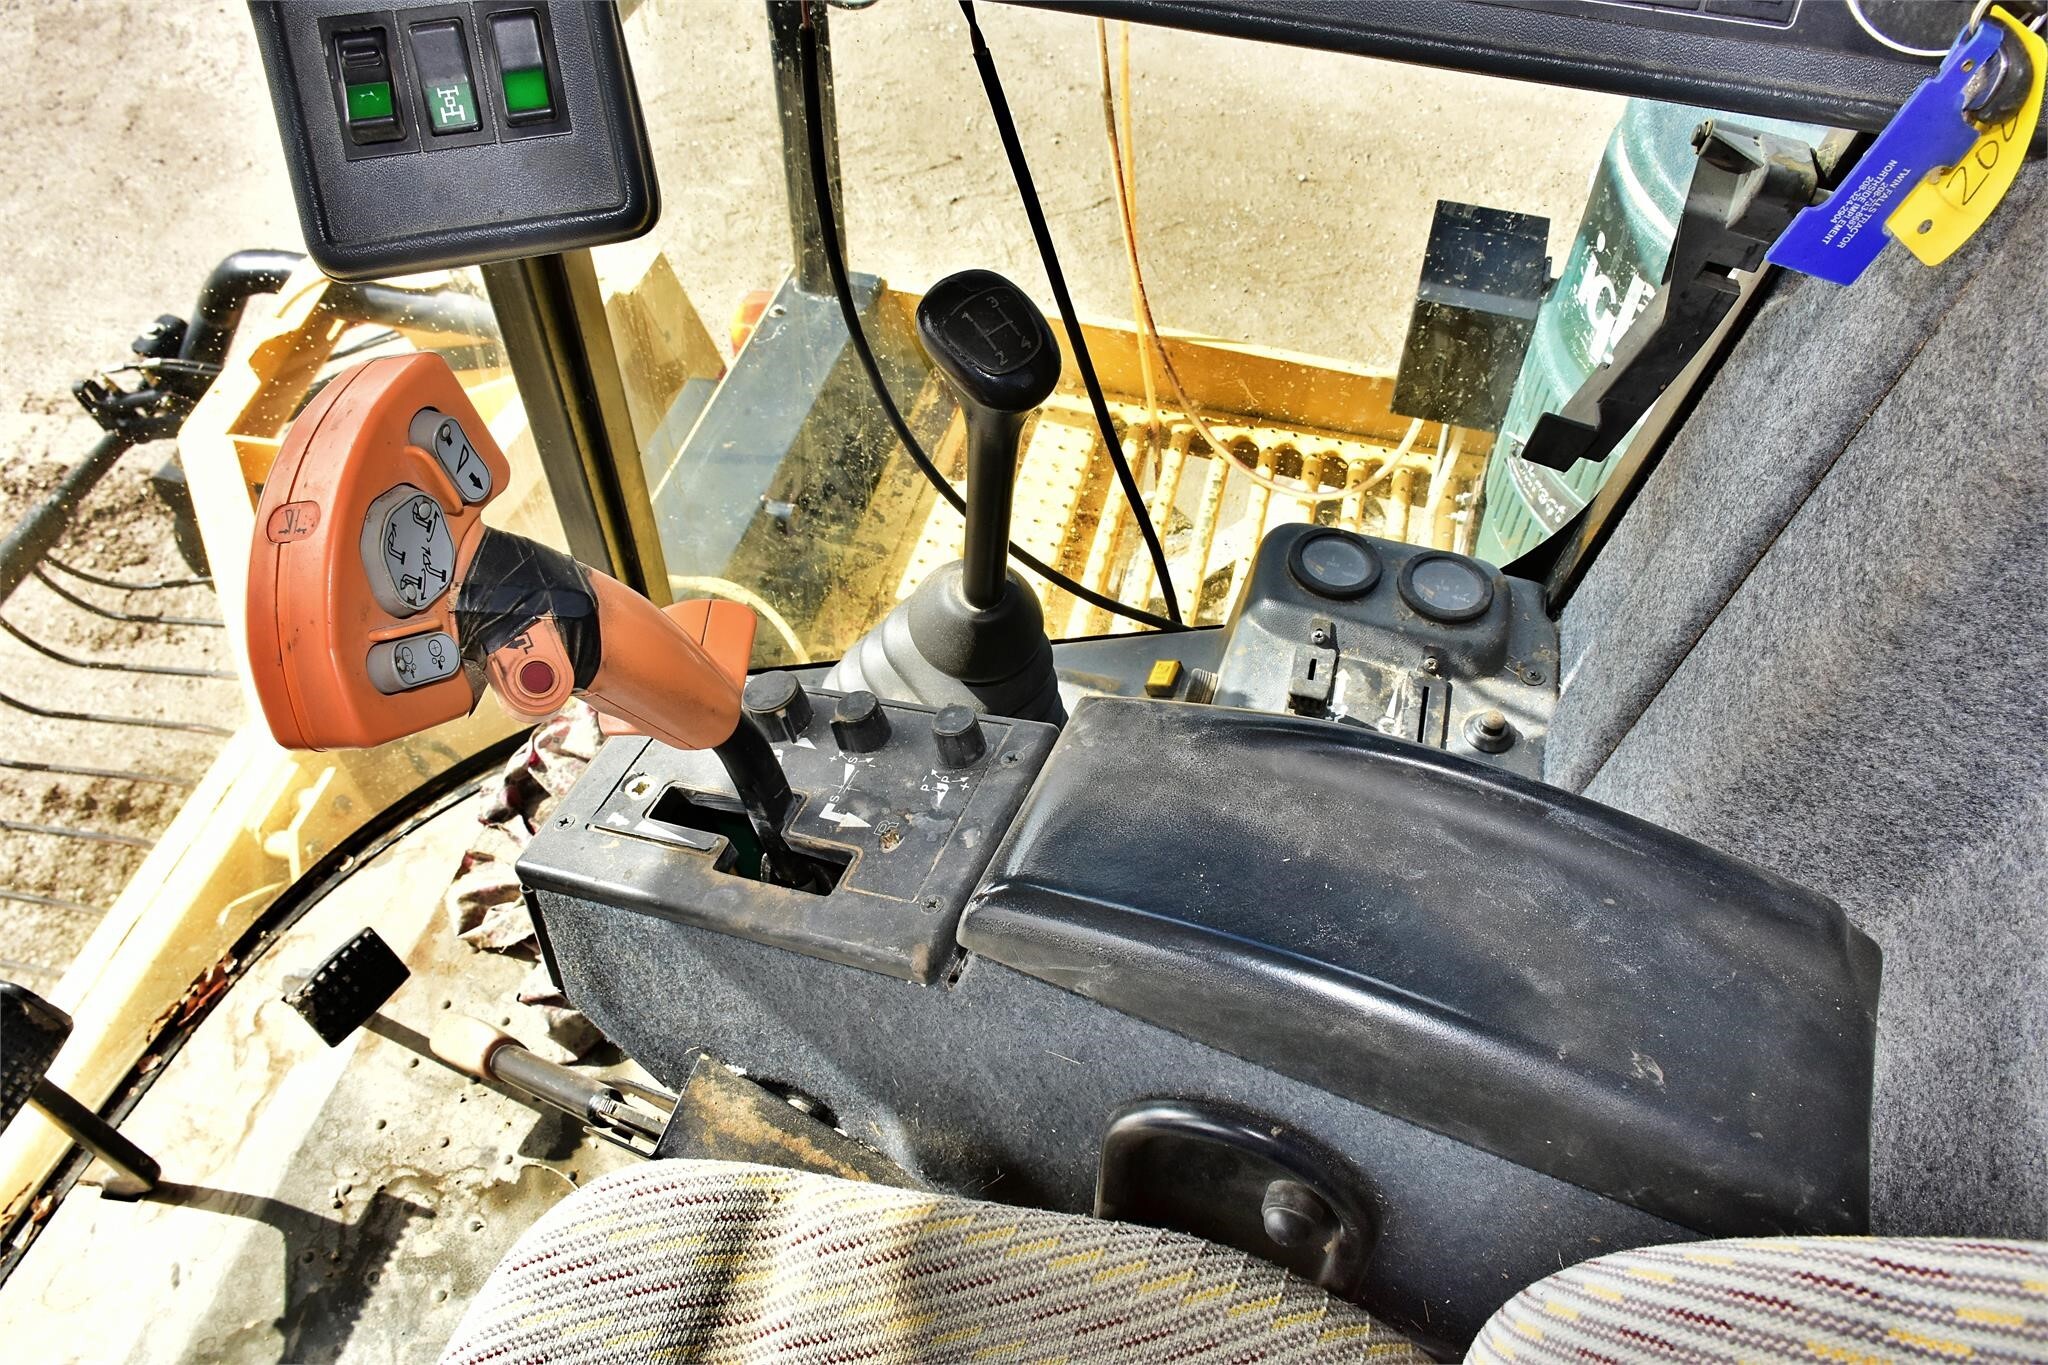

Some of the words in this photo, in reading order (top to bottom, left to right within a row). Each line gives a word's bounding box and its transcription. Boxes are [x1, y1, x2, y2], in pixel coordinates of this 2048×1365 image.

[1857, 159, 1898, 203] NORTHSIDE
[1890, 168, 1911, 188] TWIN
[1830, 175, 1874, 223] 208-324-2904
[1869, 188, 1893, 213] FALLS
[1822, 203, 1860, 245] IMPLEMENT
[1837, 214, 1872, 248] TRACTOR
[986, 296, 999, 308] 3
[994, 350, 1008, 366] 2
